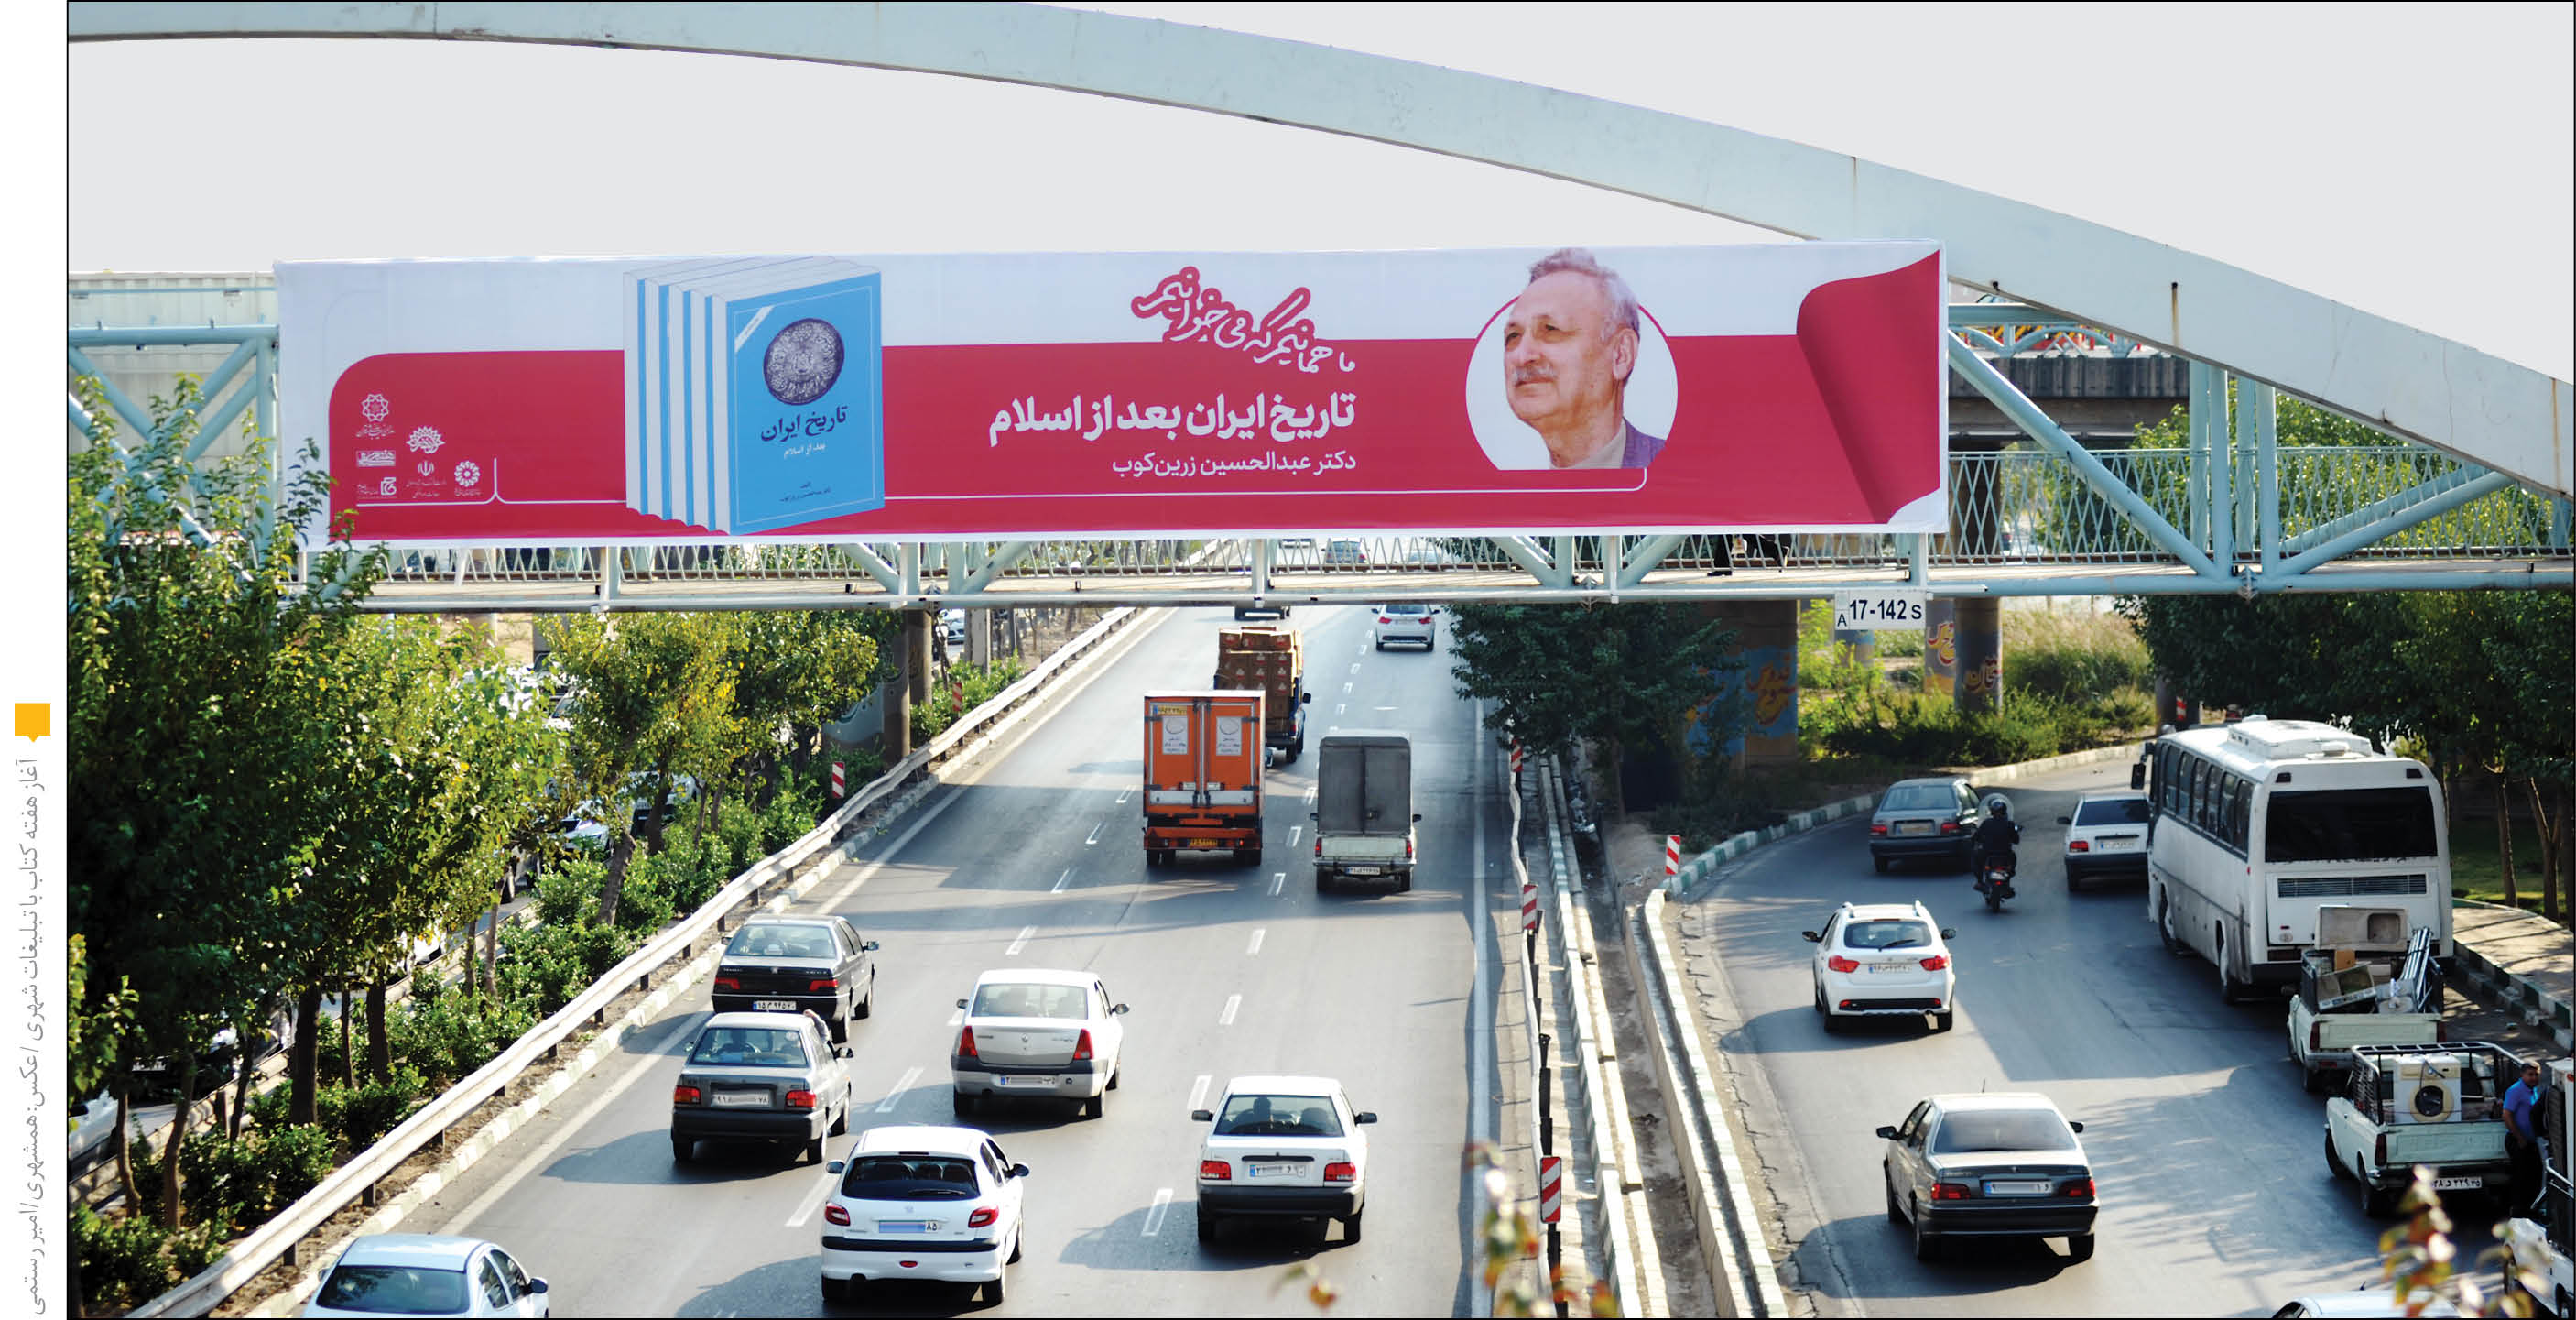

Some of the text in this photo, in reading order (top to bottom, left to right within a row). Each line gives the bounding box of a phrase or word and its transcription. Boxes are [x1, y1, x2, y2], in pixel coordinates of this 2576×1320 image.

[1253, 325, 1334, 374] همانیم
[1339, 351, 1356, 372] ما
[761, 405, 848, 442] تاریخ ایران
[989, 391, 1357, 448] تاریخ ایران بعد از اسلام
[1200, 451, 1311, 476] عبدالحسین
[1312, 450, 1356, 476] دکتر
[1837, 613, 1847, 627] A
[1849, 599, 1907, 620] 17-142
